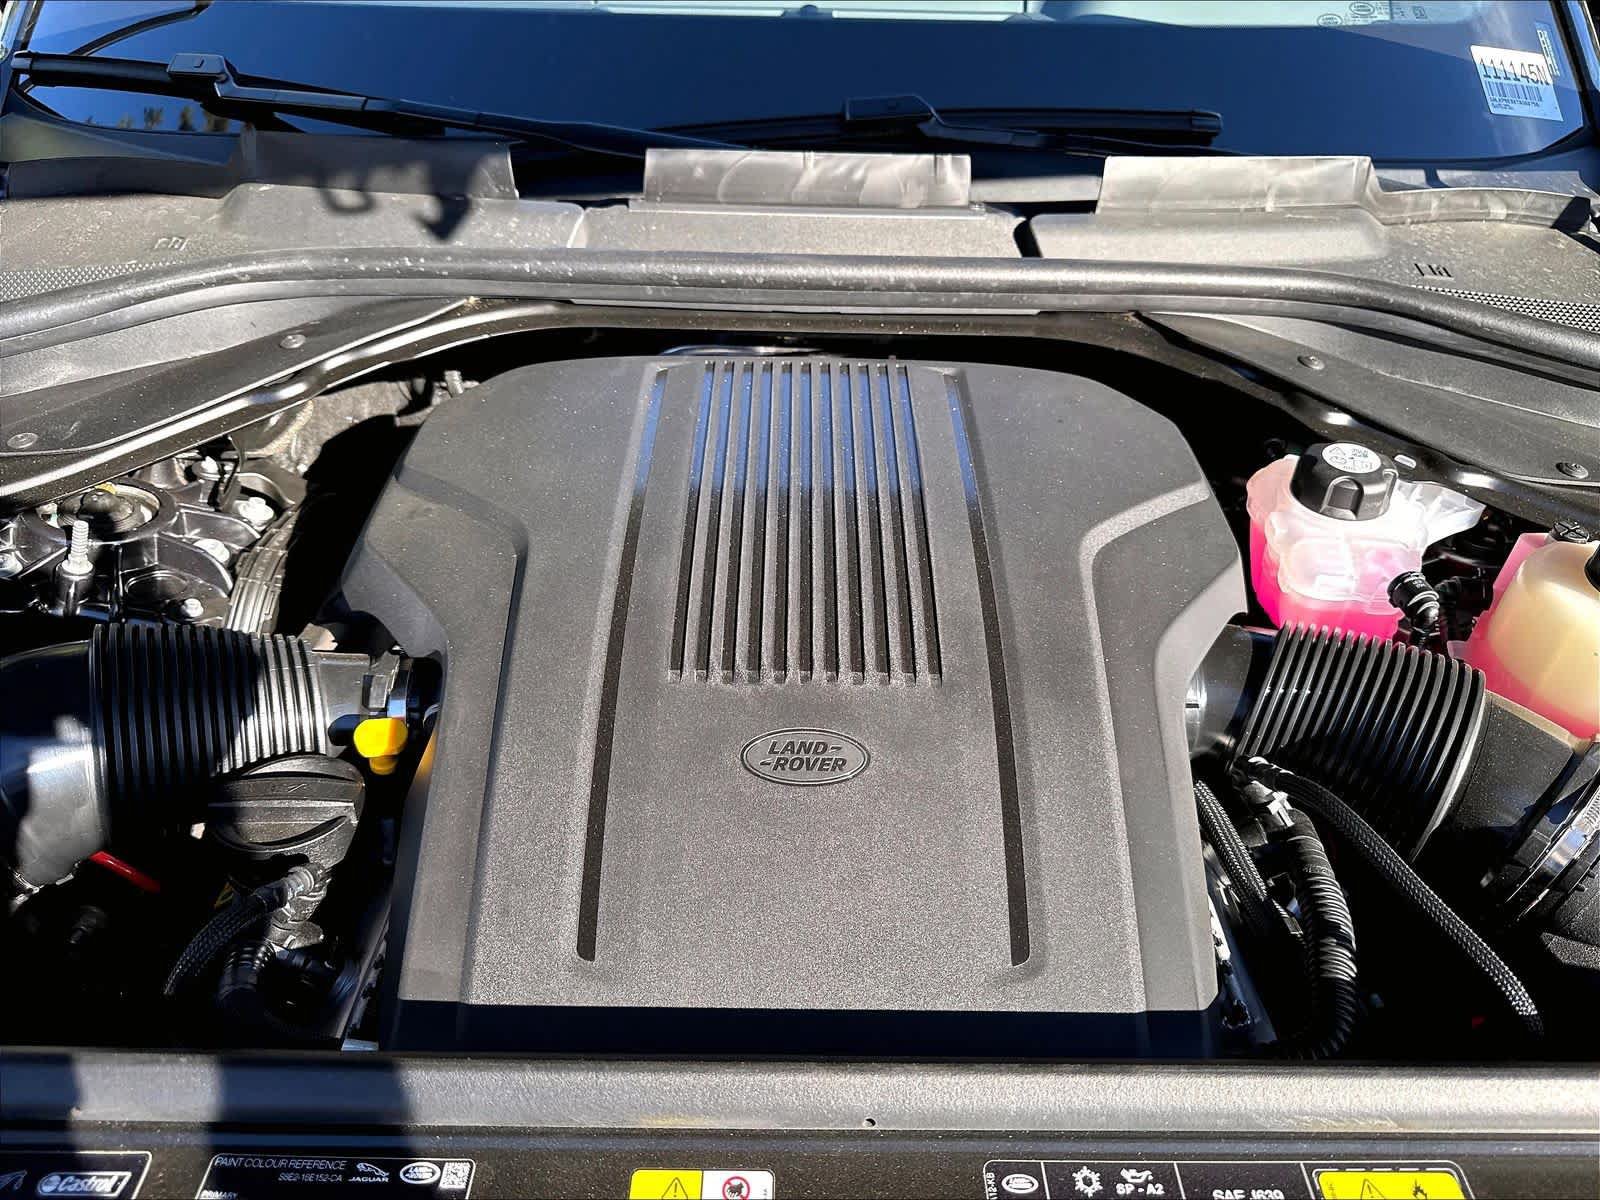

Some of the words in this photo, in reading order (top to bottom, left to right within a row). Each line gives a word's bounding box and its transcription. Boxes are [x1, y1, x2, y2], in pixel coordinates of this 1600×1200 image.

[1479, 57, 1550, 86] 111145N
[768, 740, 829, 755] LAND
[772, 756, 848, 772] ROVER
[214, 1156, 243, 1168] PAINT
[244, 1157, 288, 1169] COLOUR
[288, 1159, 347, 1170] REFERENCE
[57, 1174, 119, 1192] Castrol
